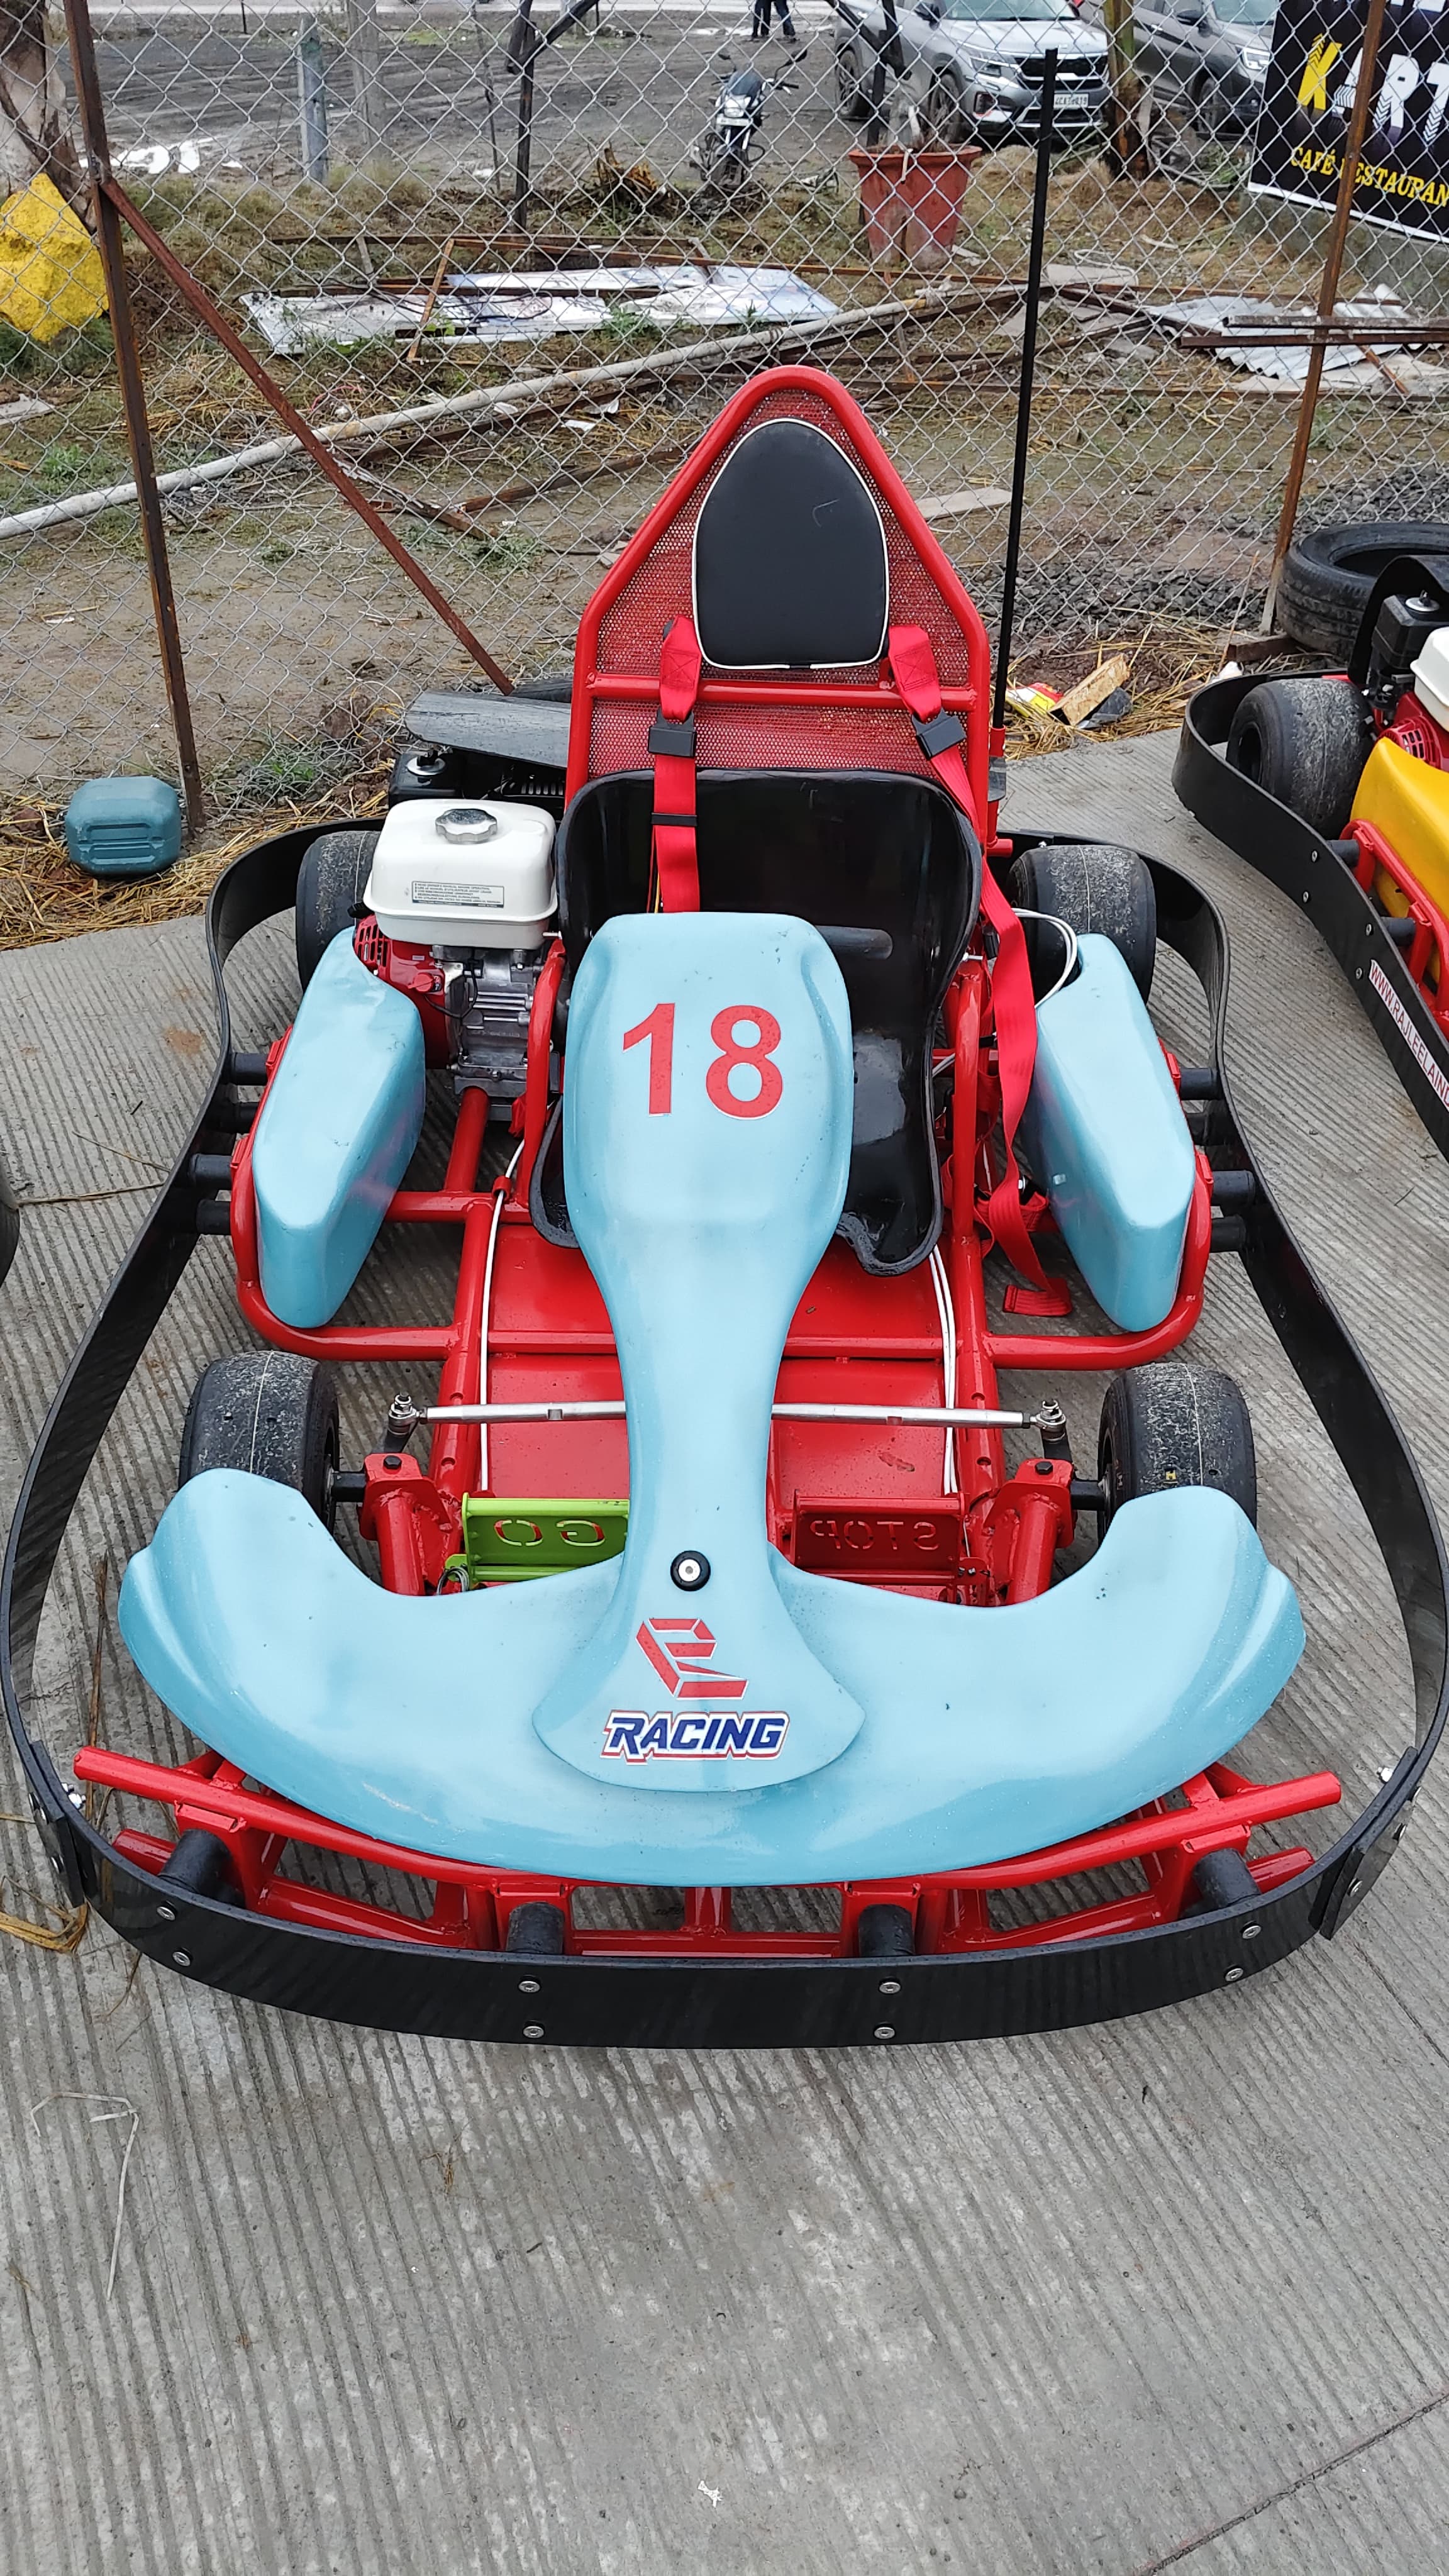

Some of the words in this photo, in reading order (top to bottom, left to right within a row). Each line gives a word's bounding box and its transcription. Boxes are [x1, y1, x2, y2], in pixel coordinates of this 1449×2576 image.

[1291, 147, 1336, 175] CAFÉ
[1340, 158, 1449, 207] ESTAURAN
[623, 1003, 783, 1119] 18
[605, 1712, 789, 1760] RACING
